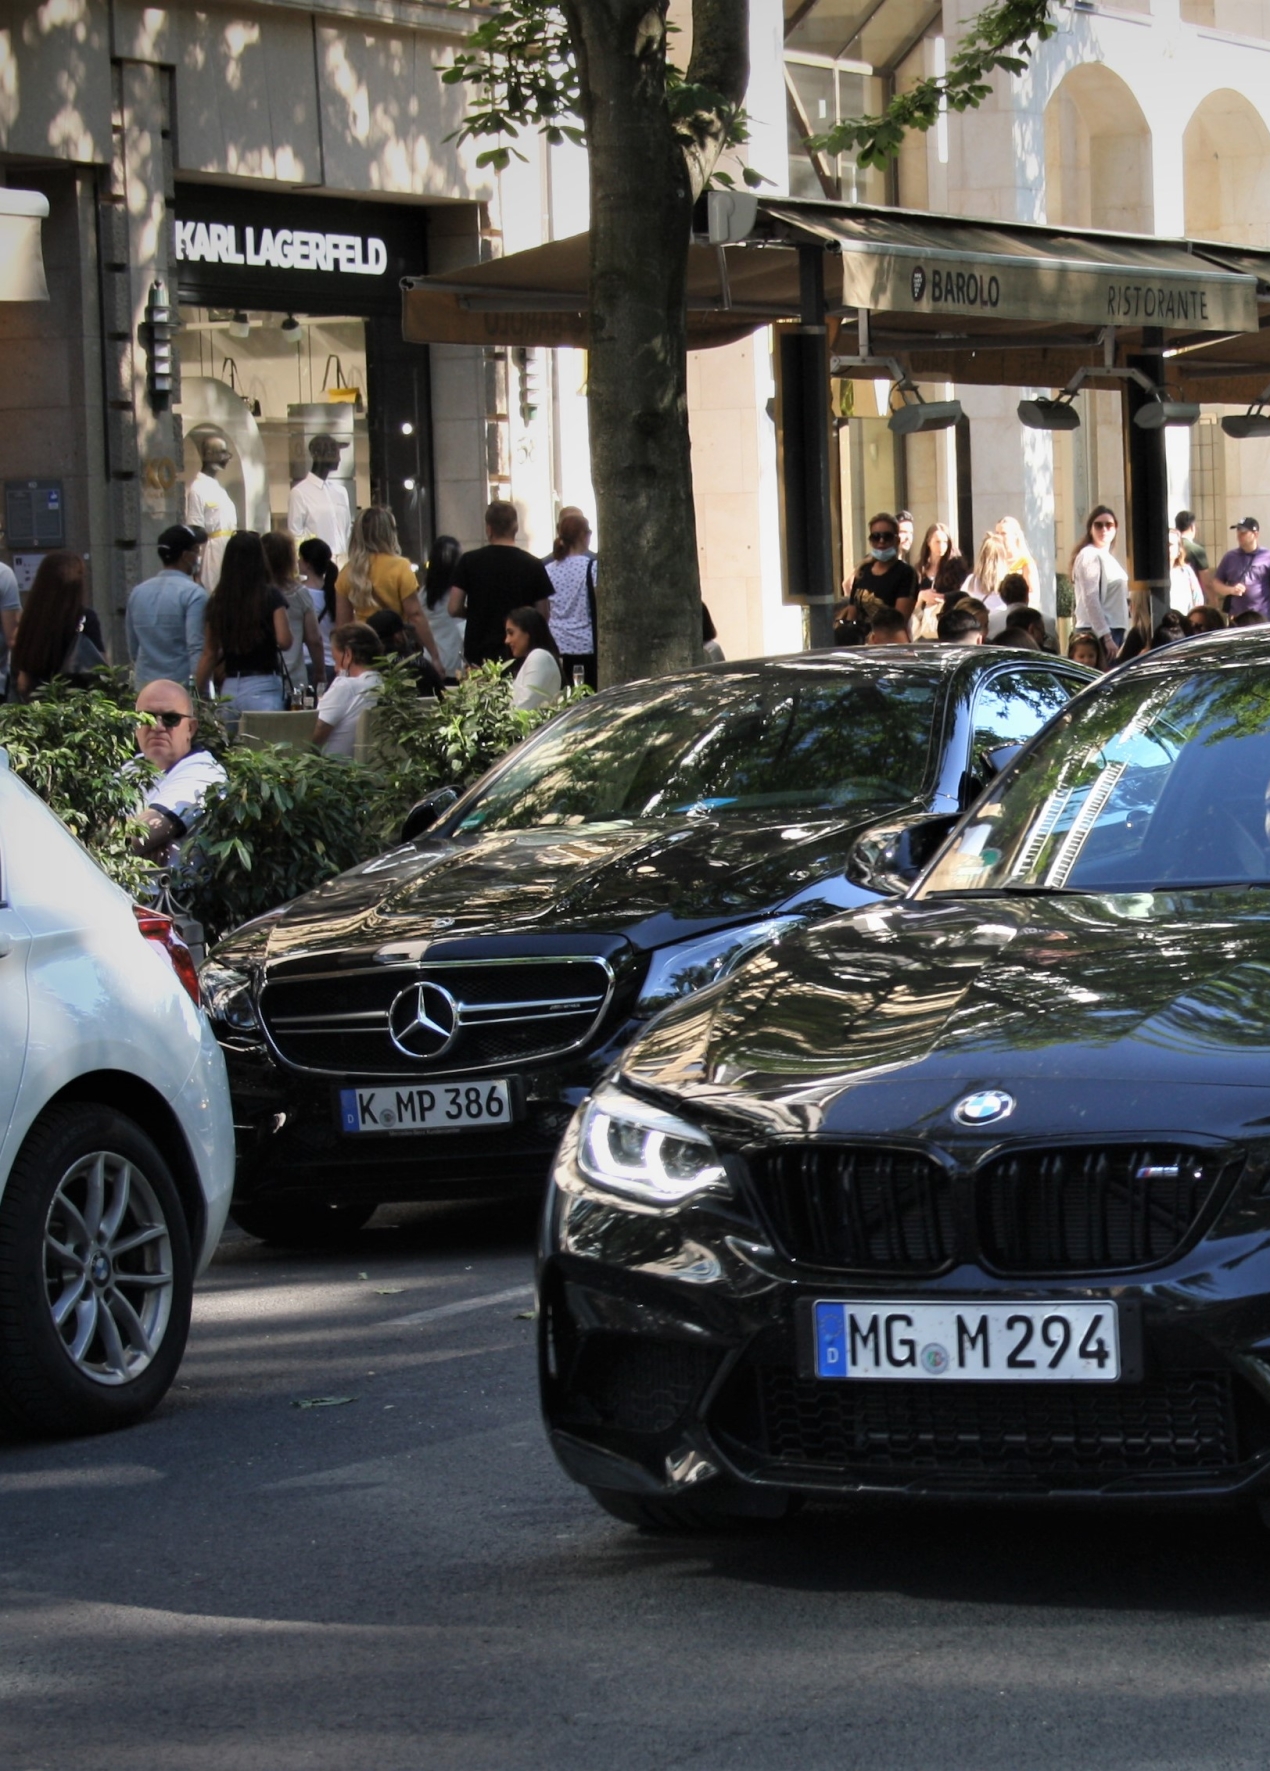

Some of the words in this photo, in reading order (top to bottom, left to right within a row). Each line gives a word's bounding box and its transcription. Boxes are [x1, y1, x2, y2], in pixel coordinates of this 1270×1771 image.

[174, 219, 245, 265] KARL
[245, 226, 388, 276] LAGERFELD
[931, 268, 1000, 309] BAROLO
[1106, 285, 1209, 321] RISTORANTE
[358, 1092, 379, 1125] K
[396, 1089, 436, 1123] MP
[444, 1085, 504, 1120] 386
[826, 1347, 840, 1364] D
[848, 1313, 917, 1368] MG
[955, 1313, 991, 1369] M
[1005, 1313, 1110, 1369] 294
